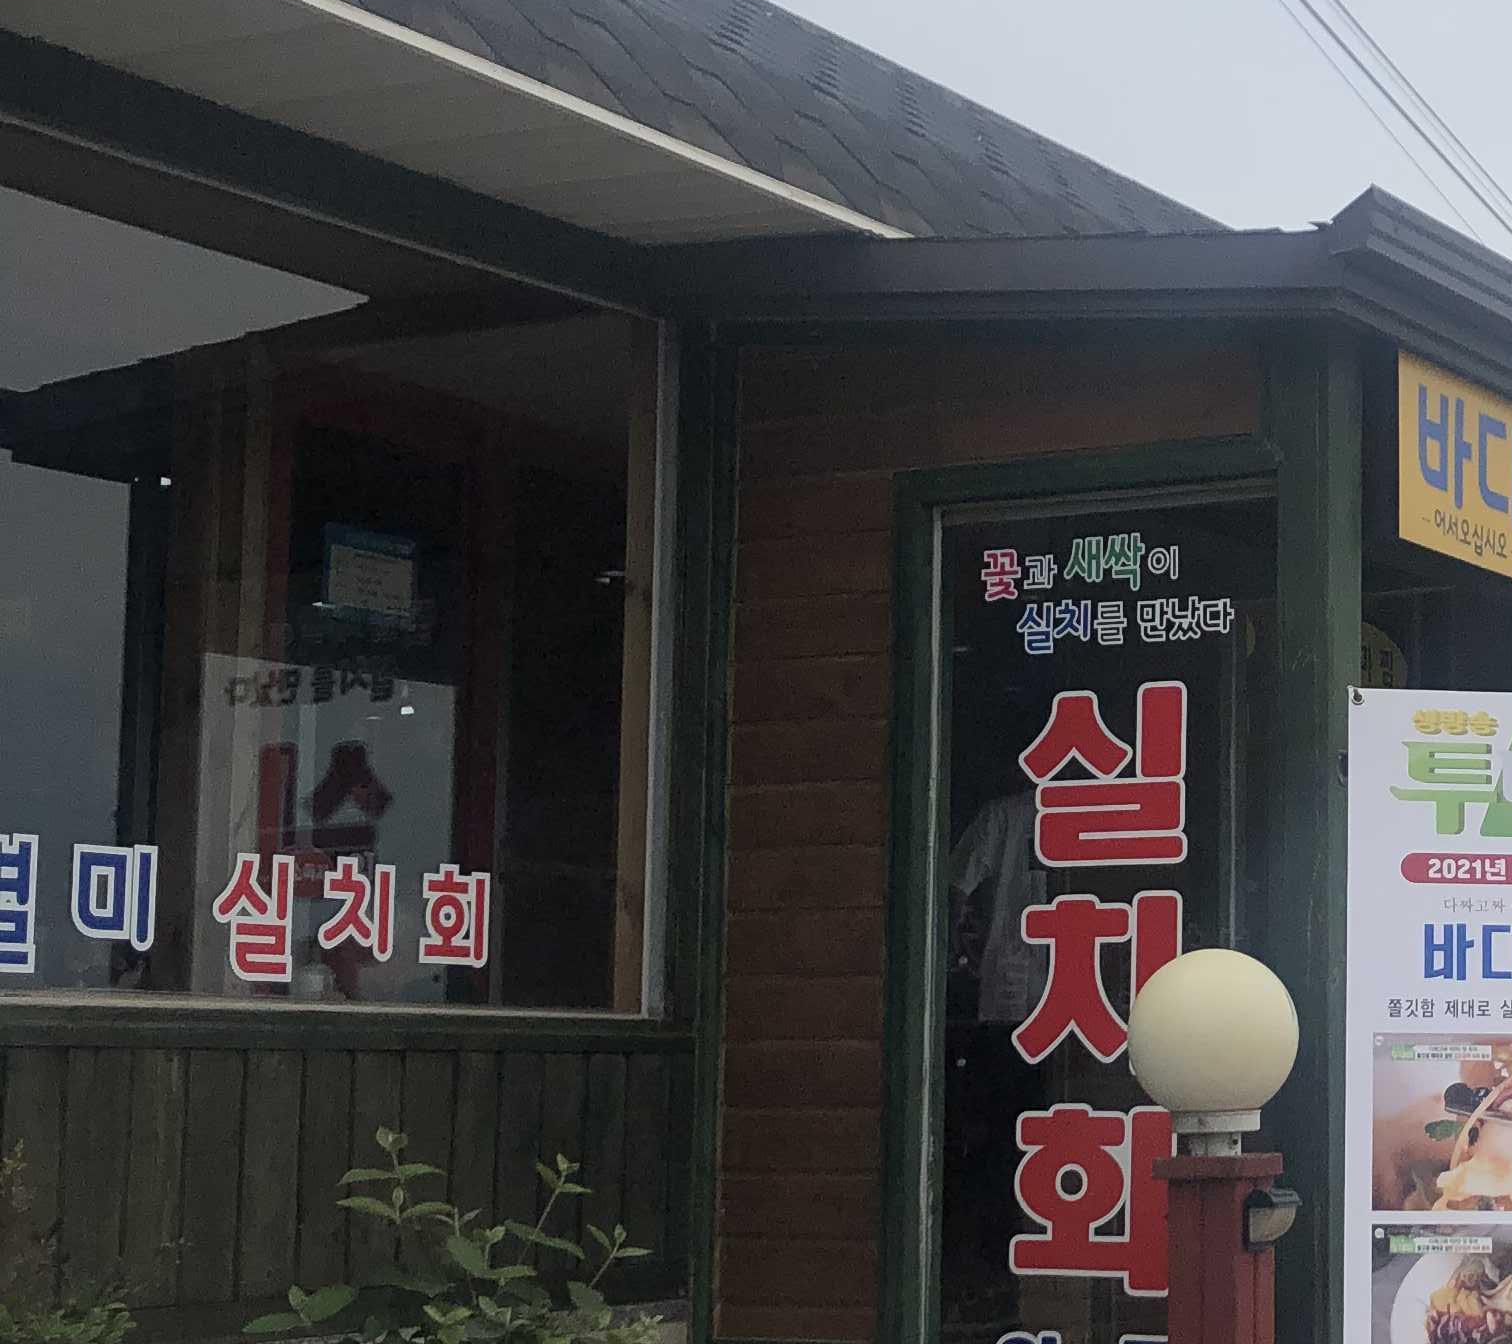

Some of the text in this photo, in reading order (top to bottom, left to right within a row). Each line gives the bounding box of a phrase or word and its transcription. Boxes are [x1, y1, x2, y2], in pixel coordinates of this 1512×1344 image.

[1433, 507, 1508, 559] 어서오십시오
[981, 532, 1179, 601] 꽃과 새싹이
[1016, 596, 1235, 654] 실치를 만났다
[1427, 858, 1507, 881] 2021년
[213, 853, 492, 983] 실치회
[1387, 998, 1435, 1018] 쫄깃함
[1444, 999, 1492, 1019] 제대로
